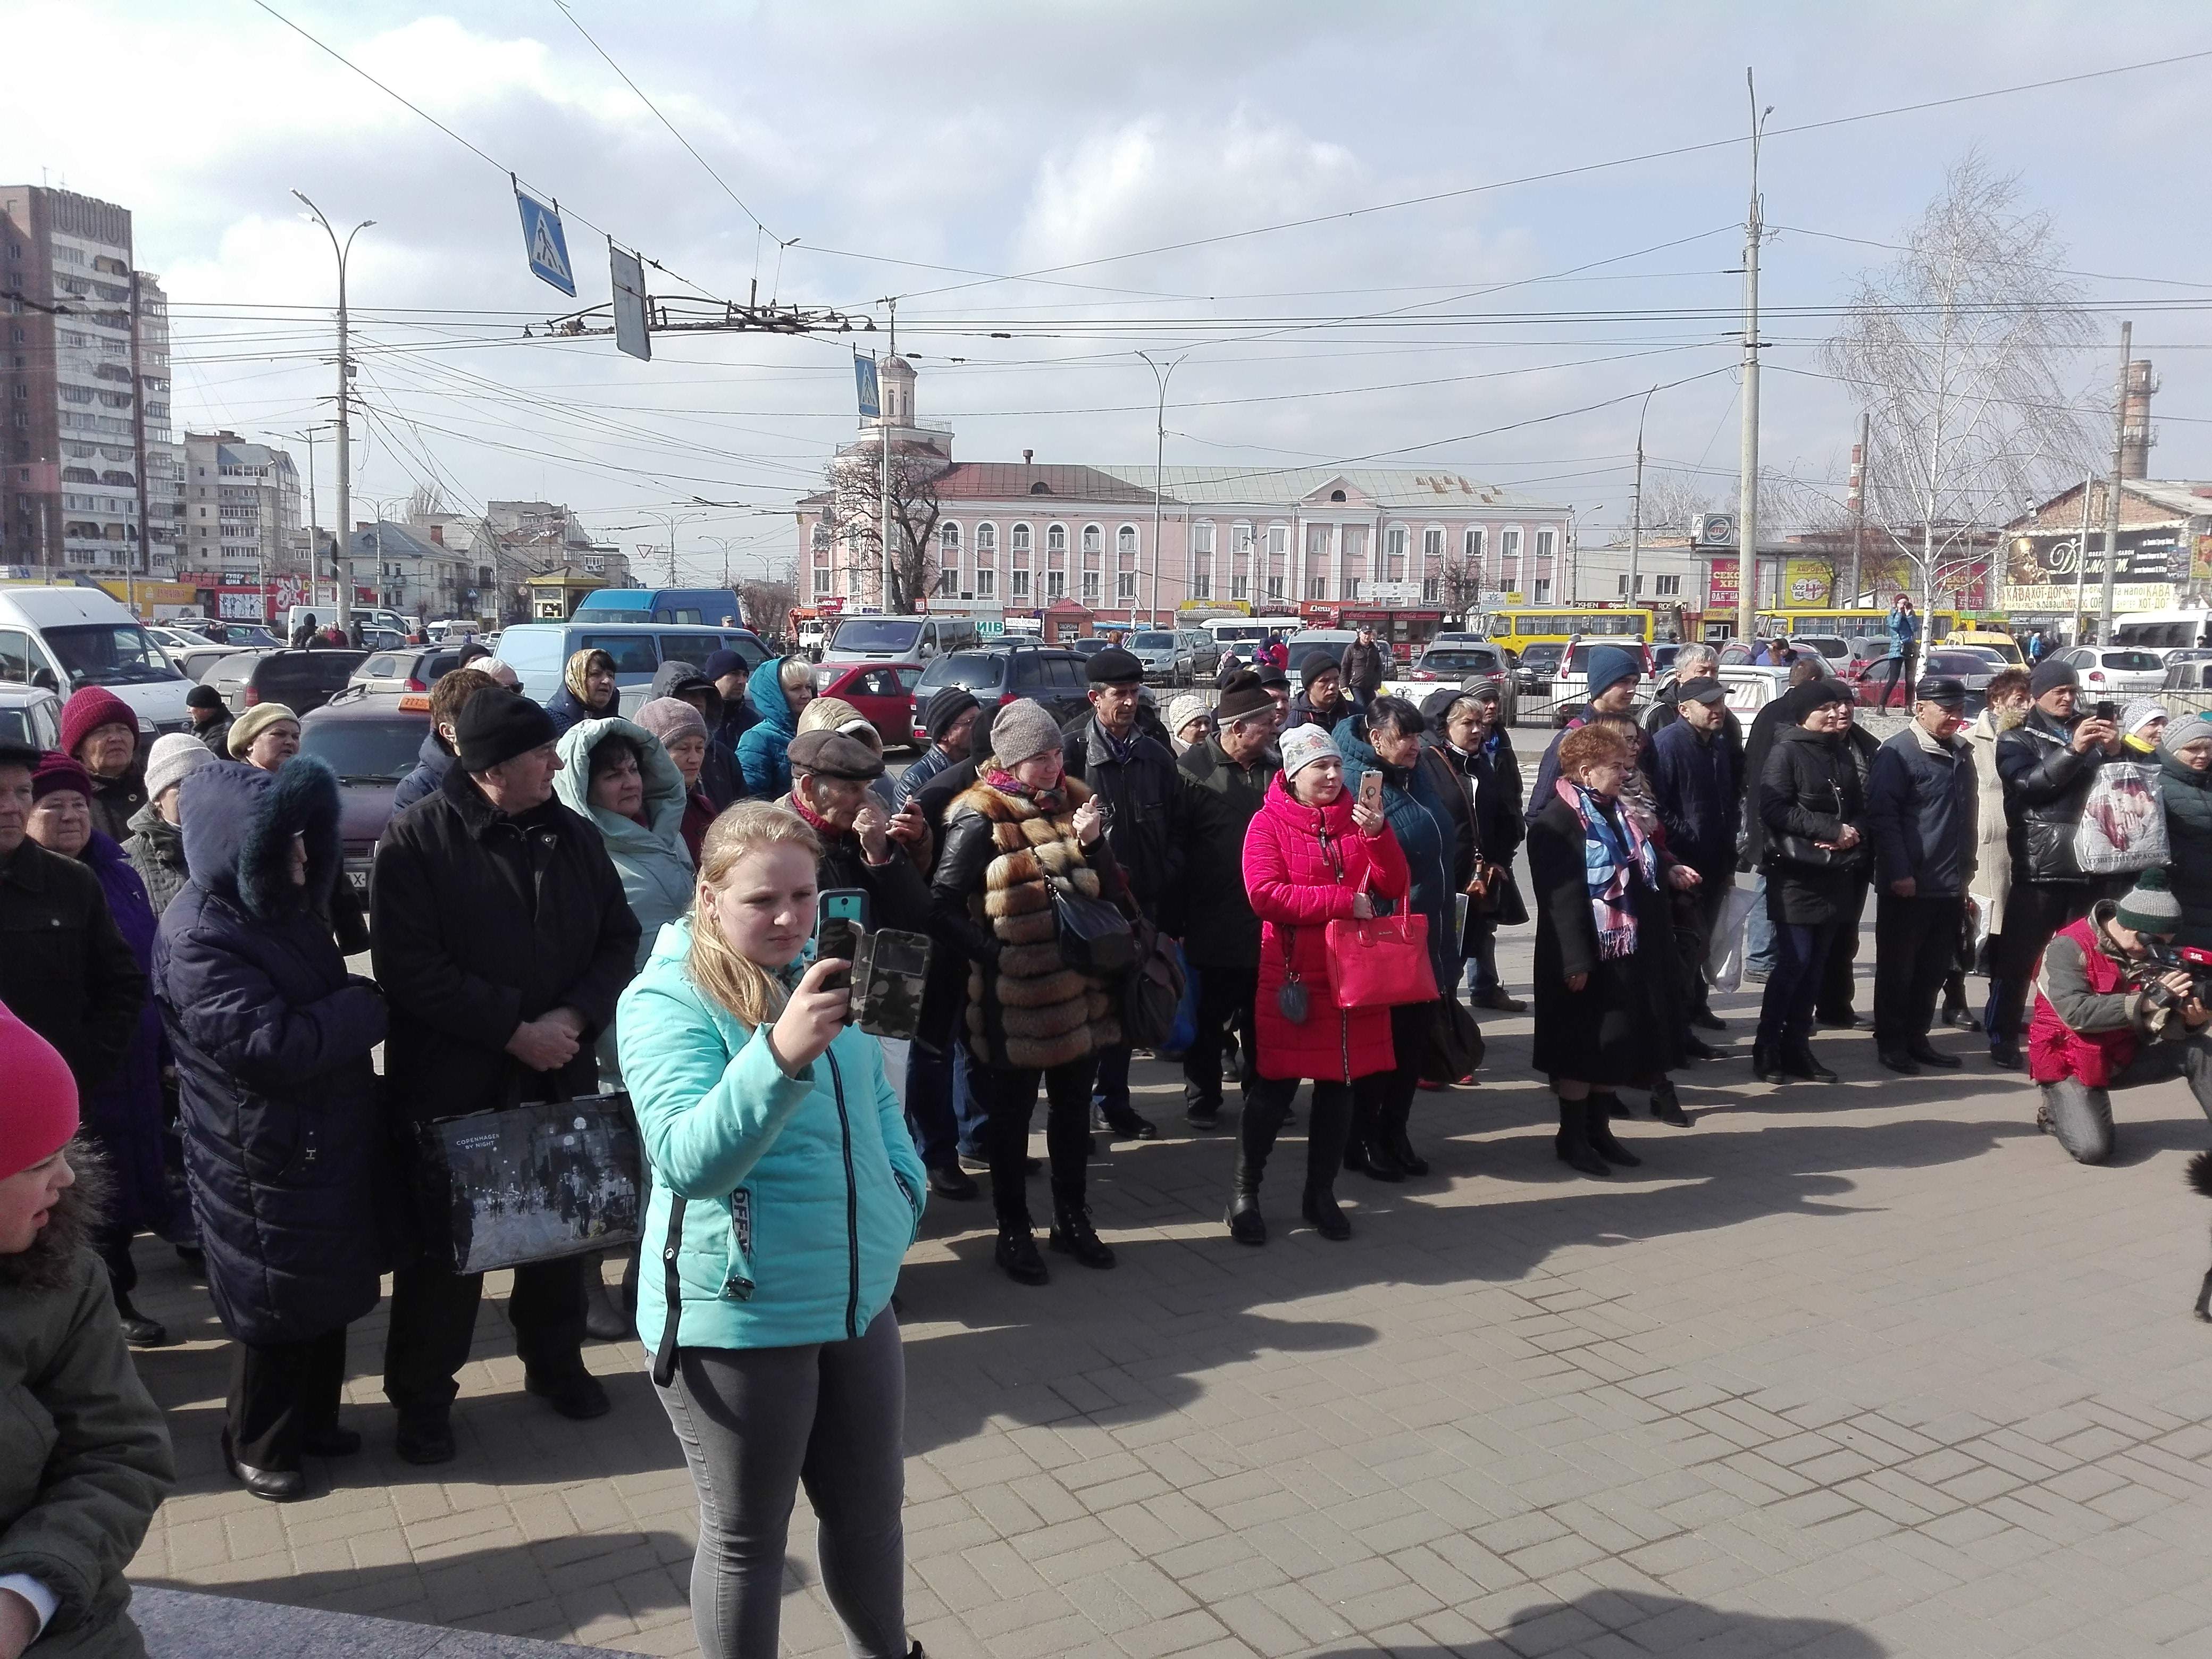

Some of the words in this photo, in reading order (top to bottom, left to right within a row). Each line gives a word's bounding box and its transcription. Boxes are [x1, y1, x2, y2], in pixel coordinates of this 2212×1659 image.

[2007, 587, 2031, 601] КАВА
[2146, 585, 2170, 597] КАВА
[456, 1134, 499, 1145] COPENHAGEN
